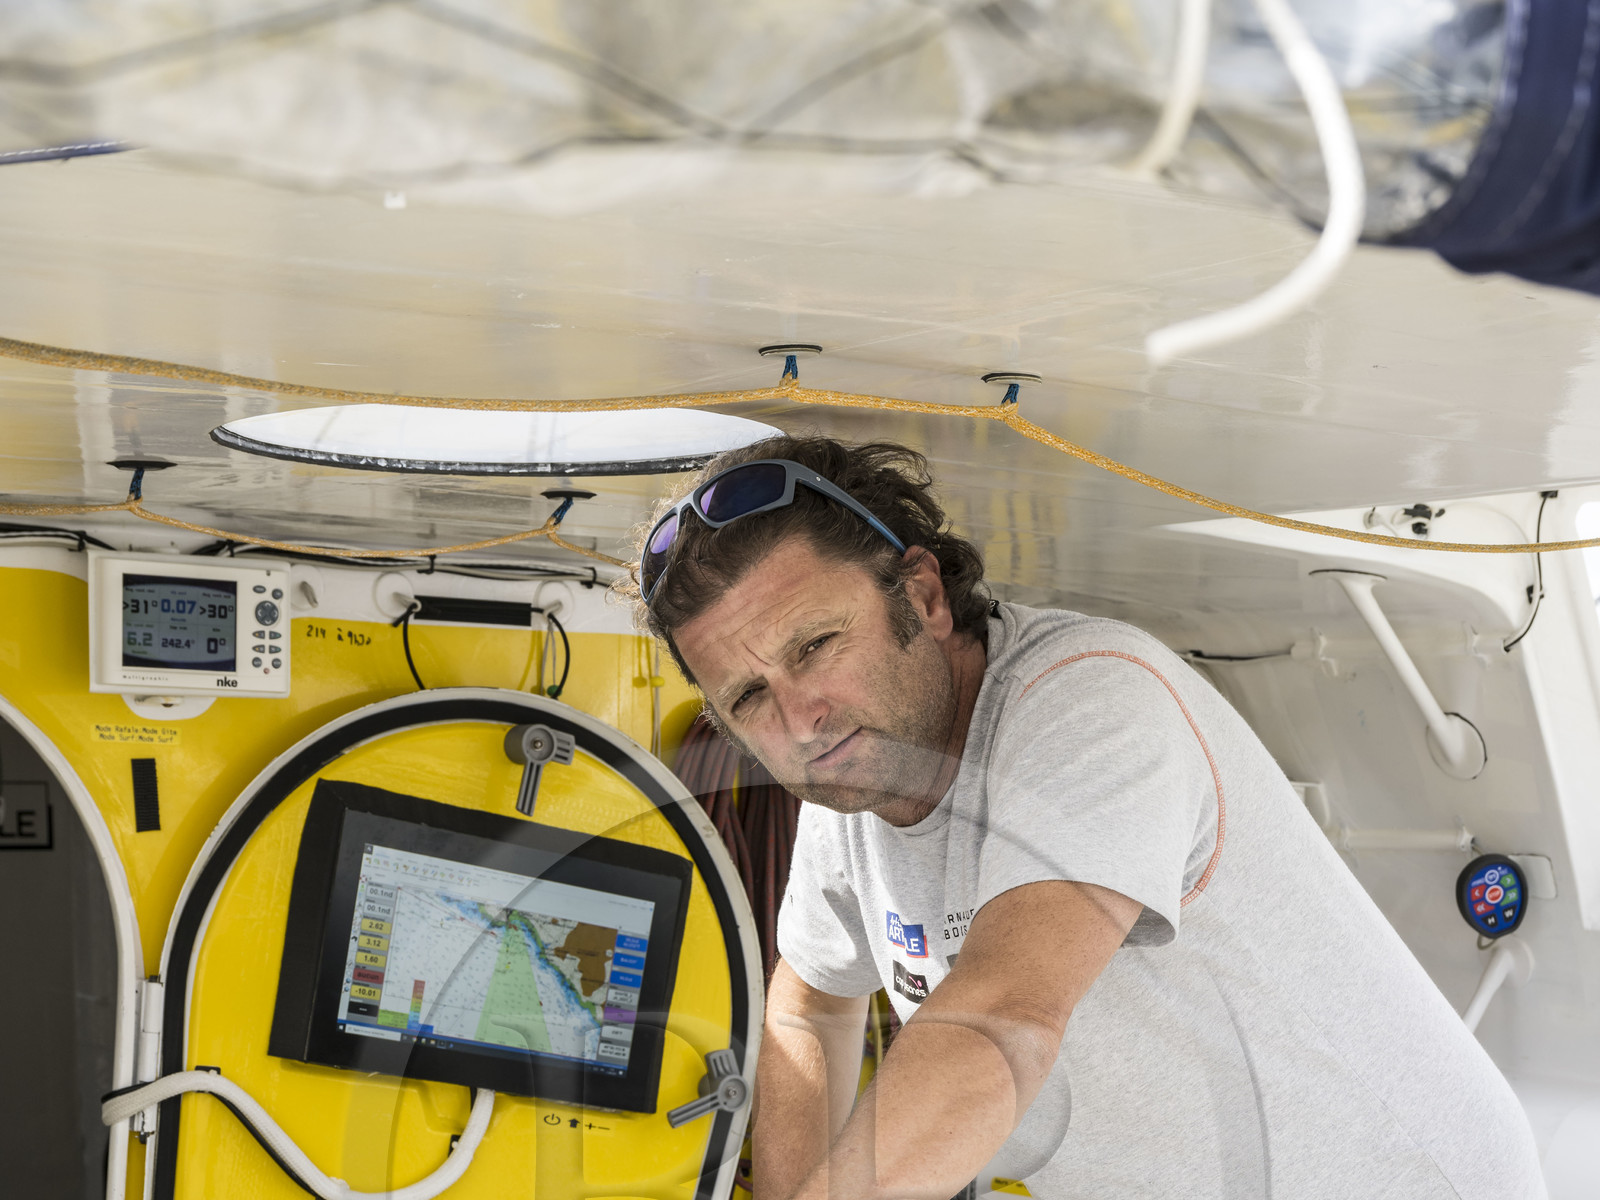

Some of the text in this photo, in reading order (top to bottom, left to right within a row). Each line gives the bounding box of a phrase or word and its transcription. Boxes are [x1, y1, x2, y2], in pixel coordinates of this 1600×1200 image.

[161, 599, 197, 614] 0.07
[127, 631, 153, 647] 6.2
[216, 676, 238, 688] nke
